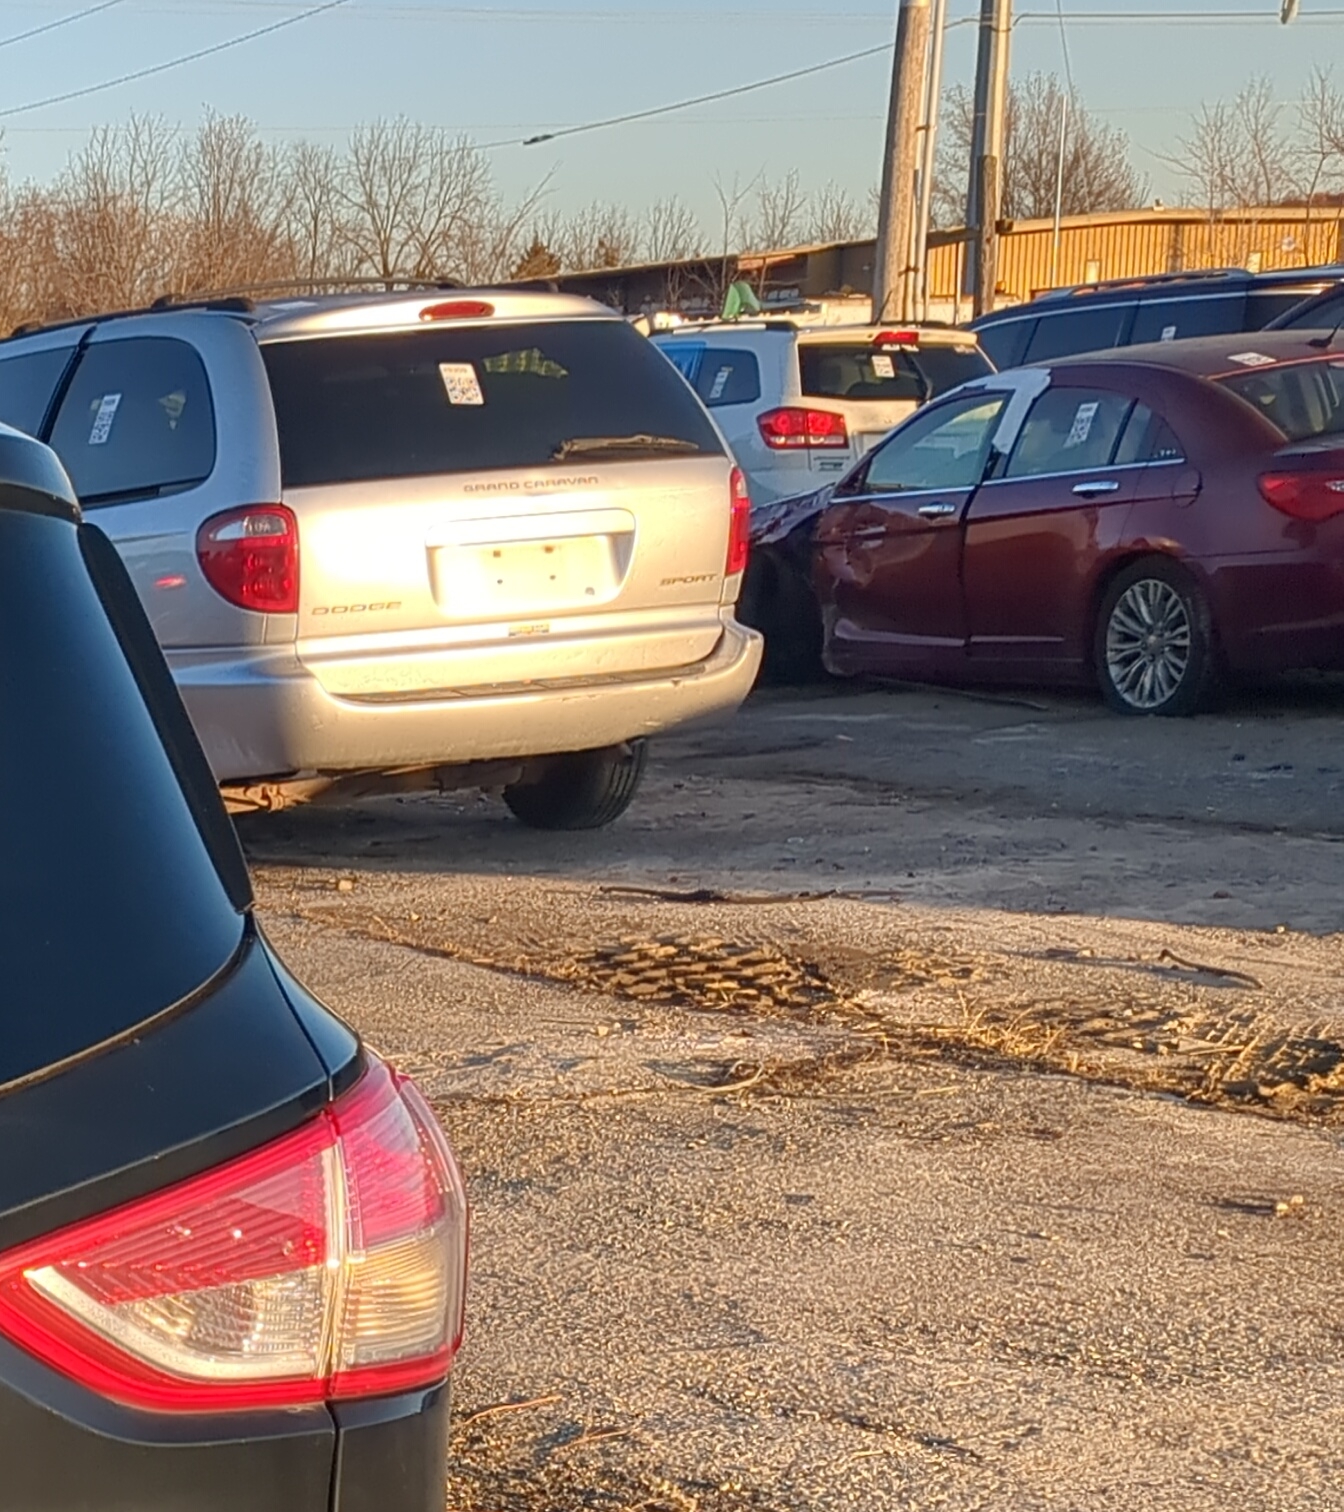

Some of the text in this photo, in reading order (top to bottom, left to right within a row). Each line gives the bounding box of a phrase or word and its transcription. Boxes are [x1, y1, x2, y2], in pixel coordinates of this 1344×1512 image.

[463, 476, 599, 493] GRAND CARAVAN
[659, 573, 718, 587] SPORT
[311, 601, 402, 616] DODGE
